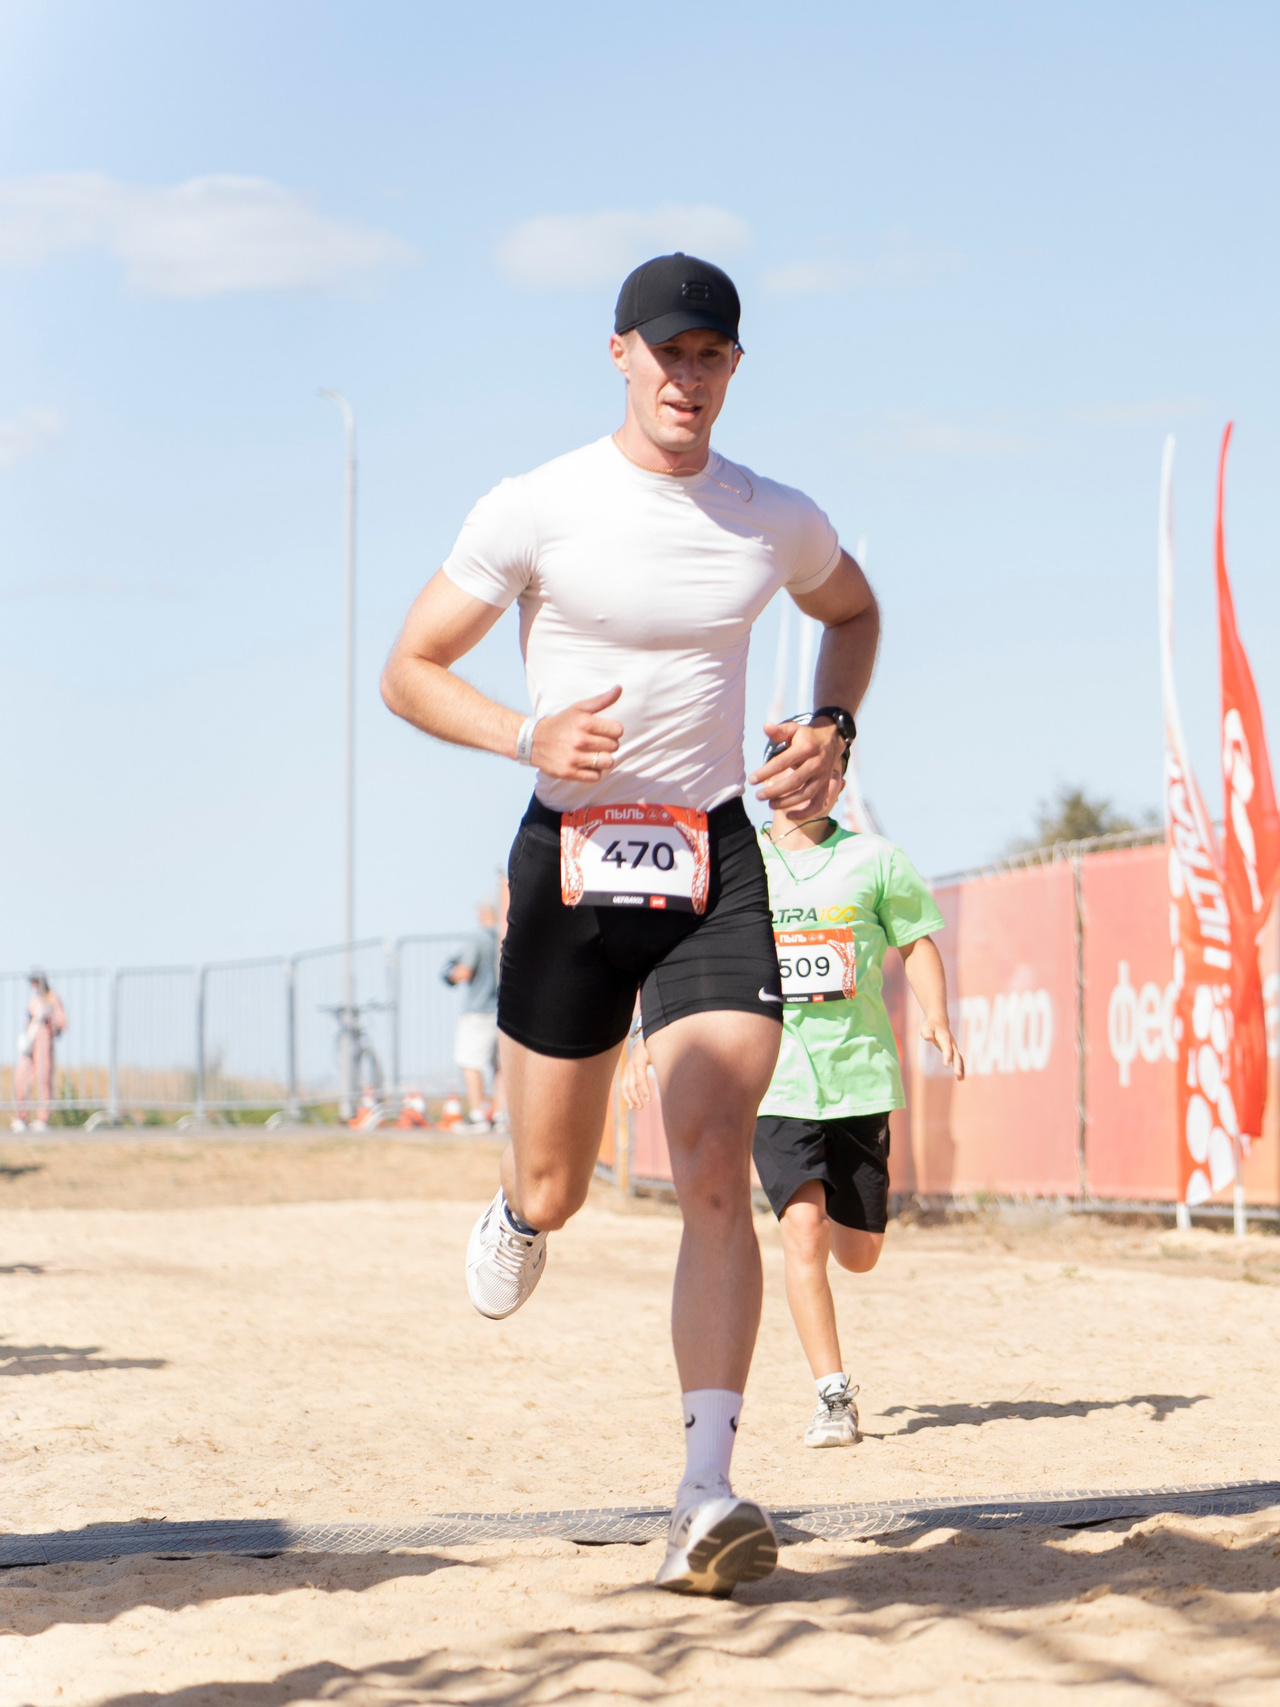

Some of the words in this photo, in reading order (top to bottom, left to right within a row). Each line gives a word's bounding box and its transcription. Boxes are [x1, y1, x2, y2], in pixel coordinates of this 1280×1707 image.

[604, 808, 644, 820] ПЫЛЬ
[601, 840, 675, 871] 470
[779, 956, 830, 978] 509
